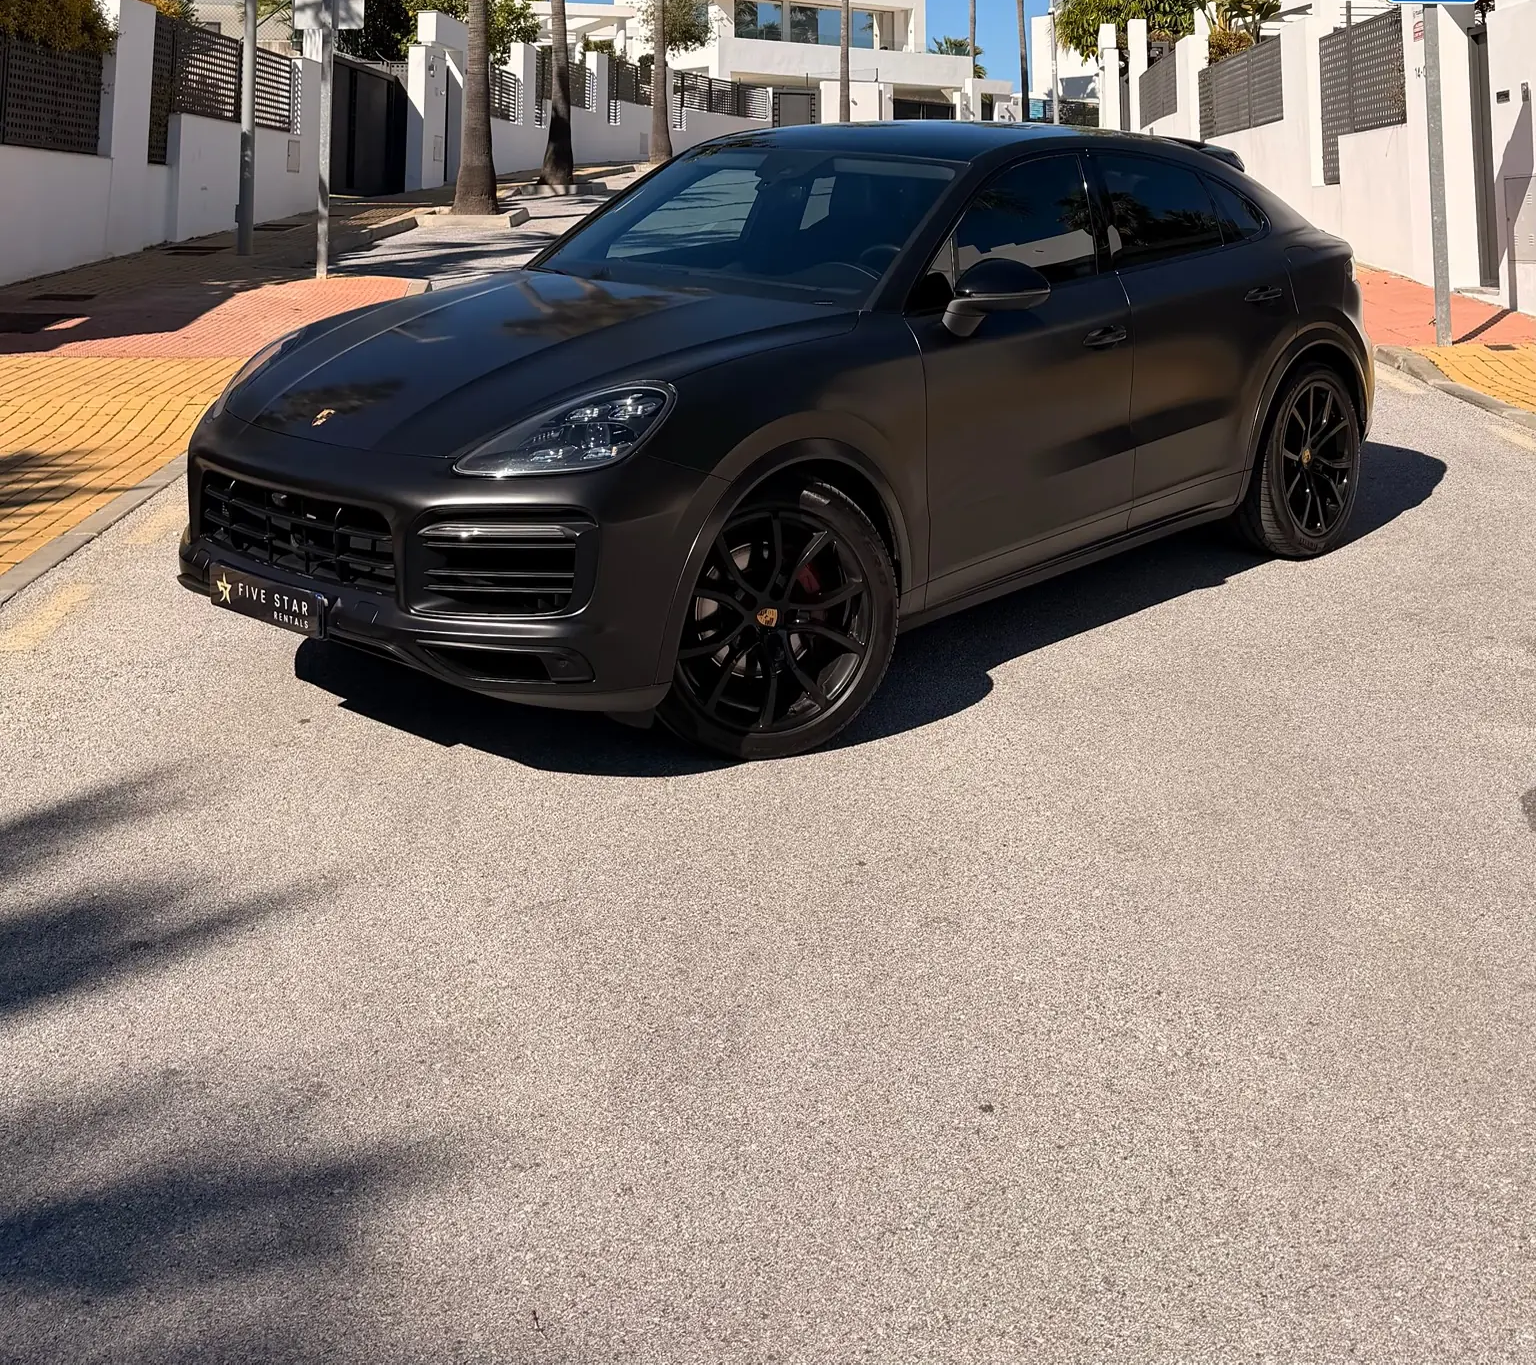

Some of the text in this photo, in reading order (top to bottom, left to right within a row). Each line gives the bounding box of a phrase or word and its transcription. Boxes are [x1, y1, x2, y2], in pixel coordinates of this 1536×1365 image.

[238, 582, 308, 616] FIVE STAR
[273, 611, 309, 629] RENTALS
